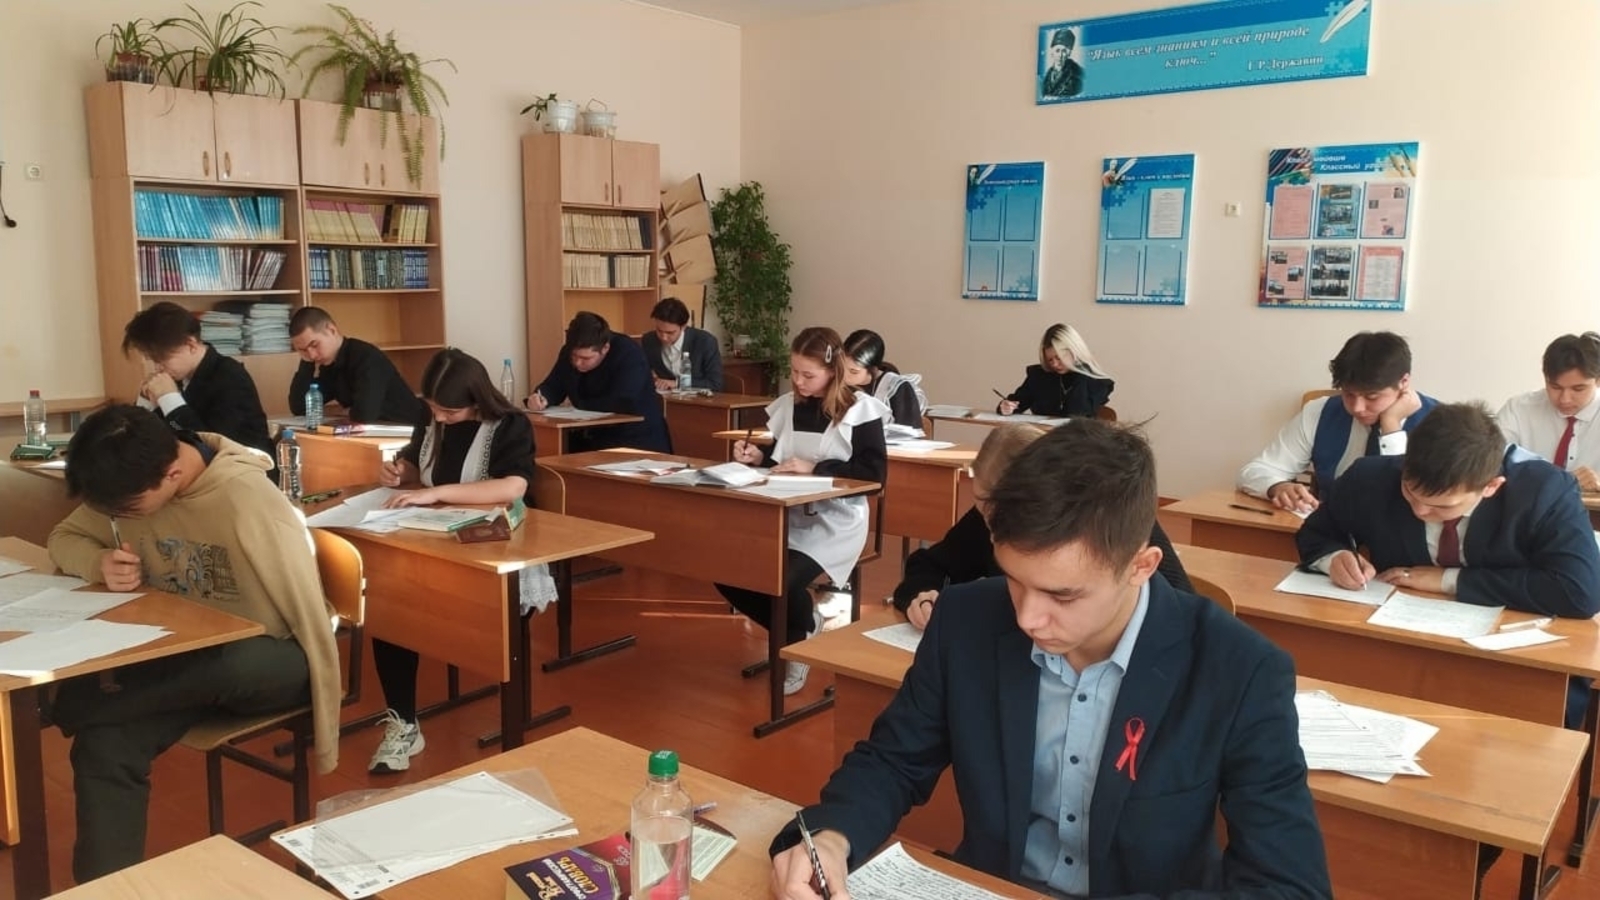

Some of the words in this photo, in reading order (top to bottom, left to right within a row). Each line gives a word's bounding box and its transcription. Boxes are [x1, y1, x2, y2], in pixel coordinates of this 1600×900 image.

[1125, 46, 1152, 57] всем
[1155, 39, 1207, 53] знаниям
[1210, 38, 1219, 46] и
[1222, 31, 1251, 44] всей
[1254, 26, 1310, 44] природе
[557, 856, 599, 894] СЛОВАРЬ
